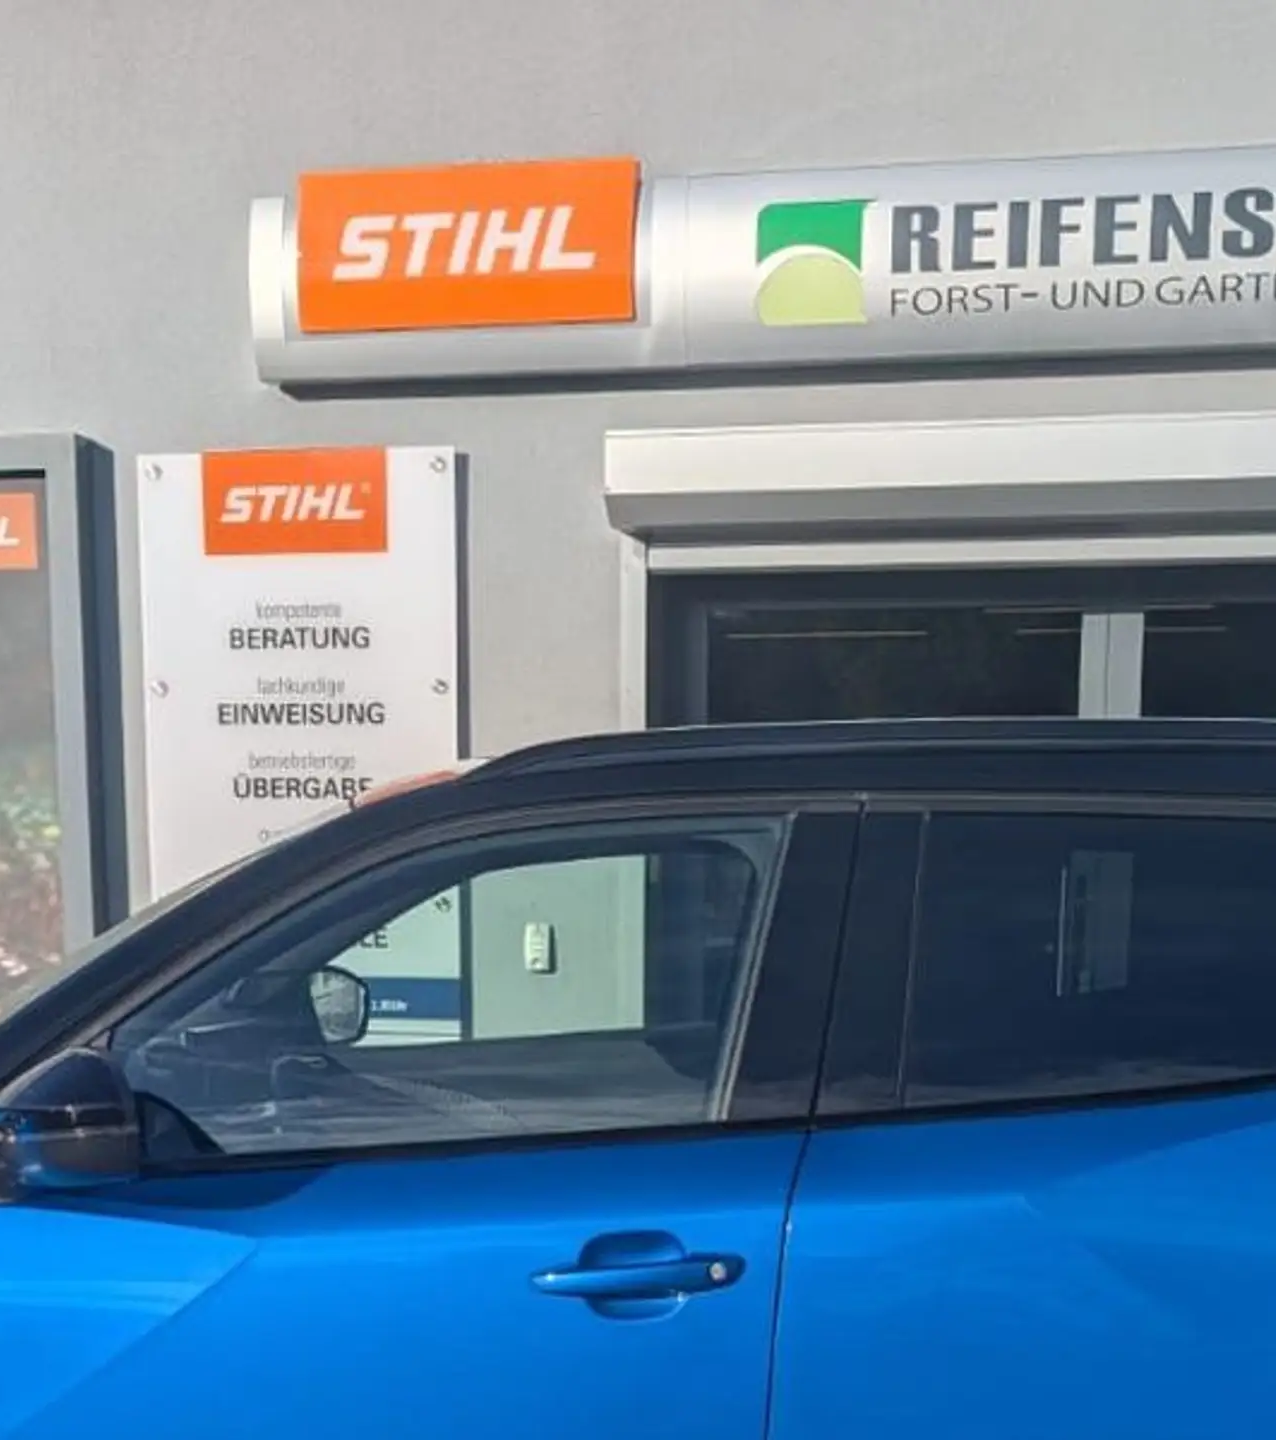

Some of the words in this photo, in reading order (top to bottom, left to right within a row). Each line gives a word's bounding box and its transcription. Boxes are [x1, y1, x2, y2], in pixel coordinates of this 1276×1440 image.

[332, 206, 596, 281] STIHL
[220, 482, 367, 522] STIHL
[229, 626, 370, 650] BERATUNG
[217, 702, 385, 725] EINWEISUNG
